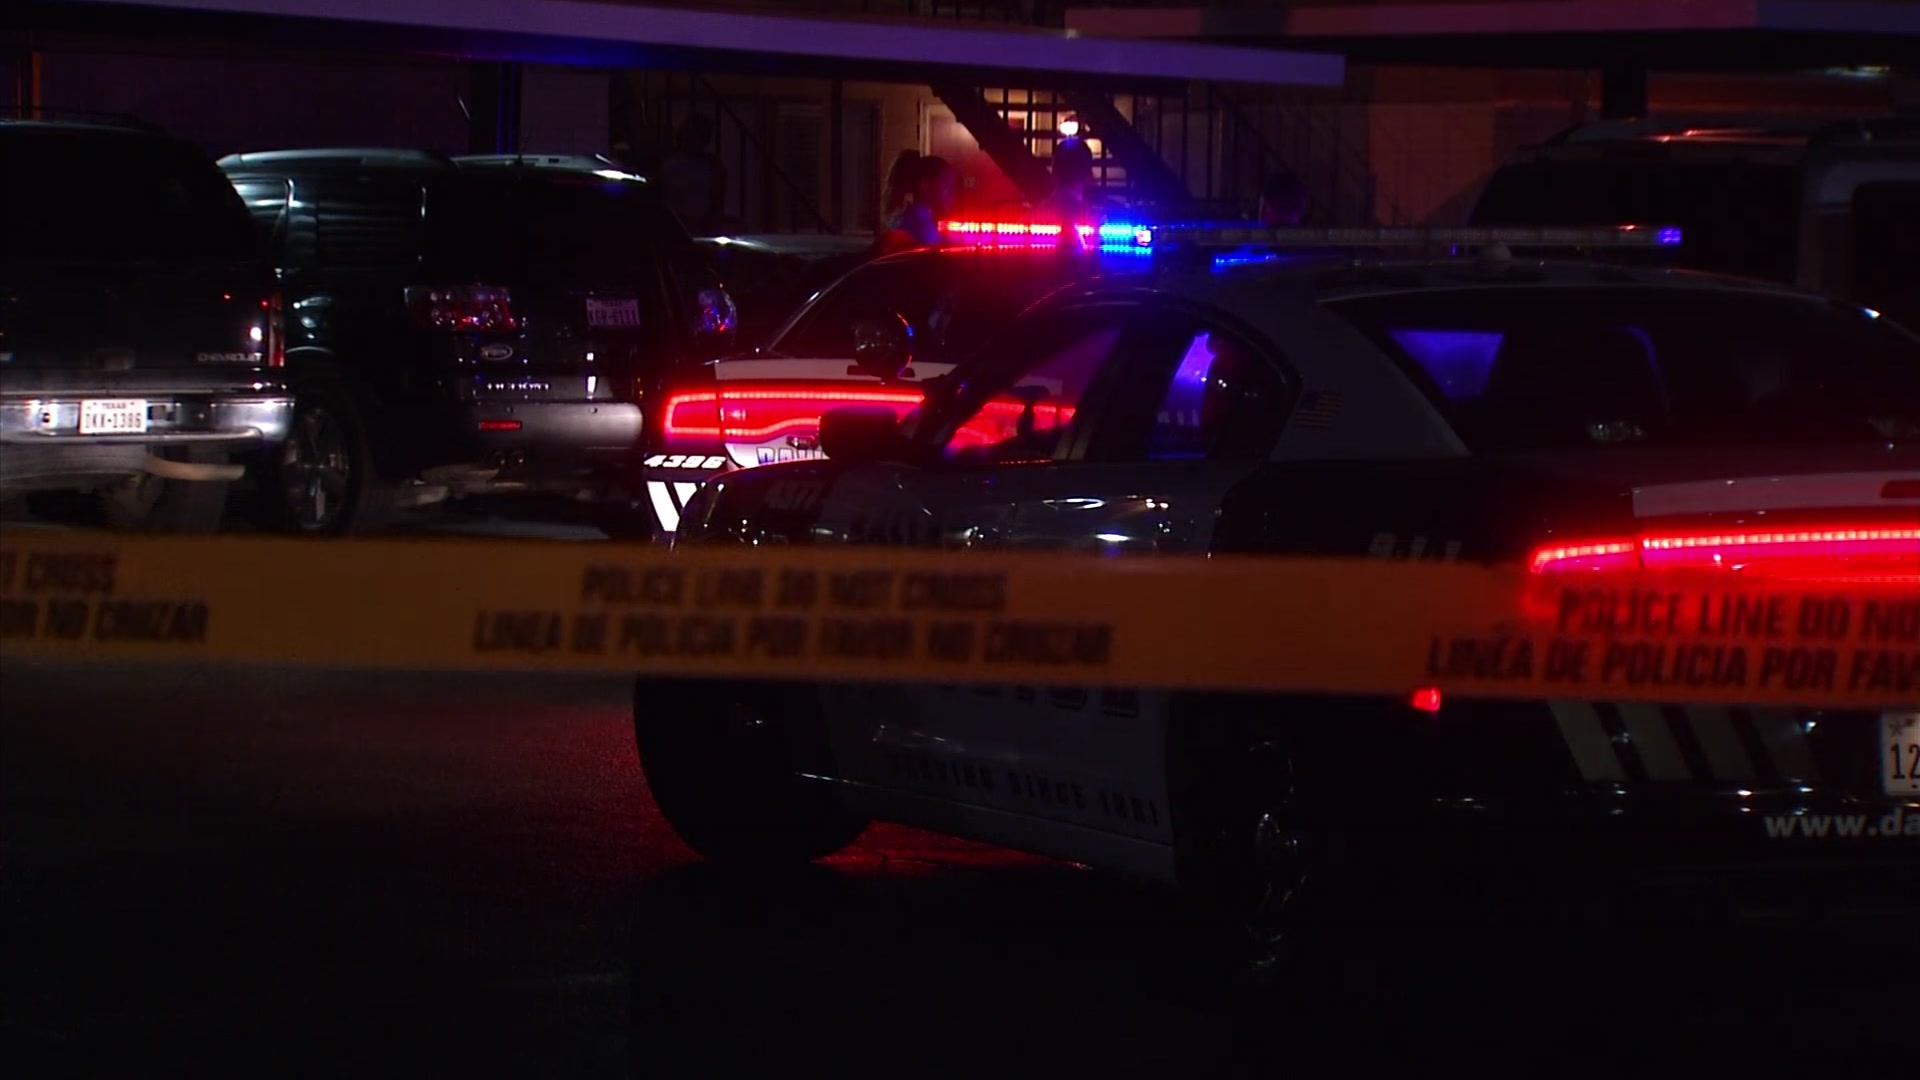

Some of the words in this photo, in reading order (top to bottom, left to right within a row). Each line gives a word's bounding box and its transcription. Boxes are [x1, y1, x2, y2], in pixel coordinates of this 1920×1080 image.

[196, 353, 262, 362] CHEVROLET
[644, 455, 726, 470] 4396
[582, 566, 686, 604] POLICE
[1556, 588, 1684, 634] POLICE
[1698, 592, 1788, 638] LINE
[1797, 597, 1850, 640] DO
[1546, 638, 1590, 683] DE
[1601, 640, 1747, 688] POLICIA
[1759, 648, 1838, 691] POR
